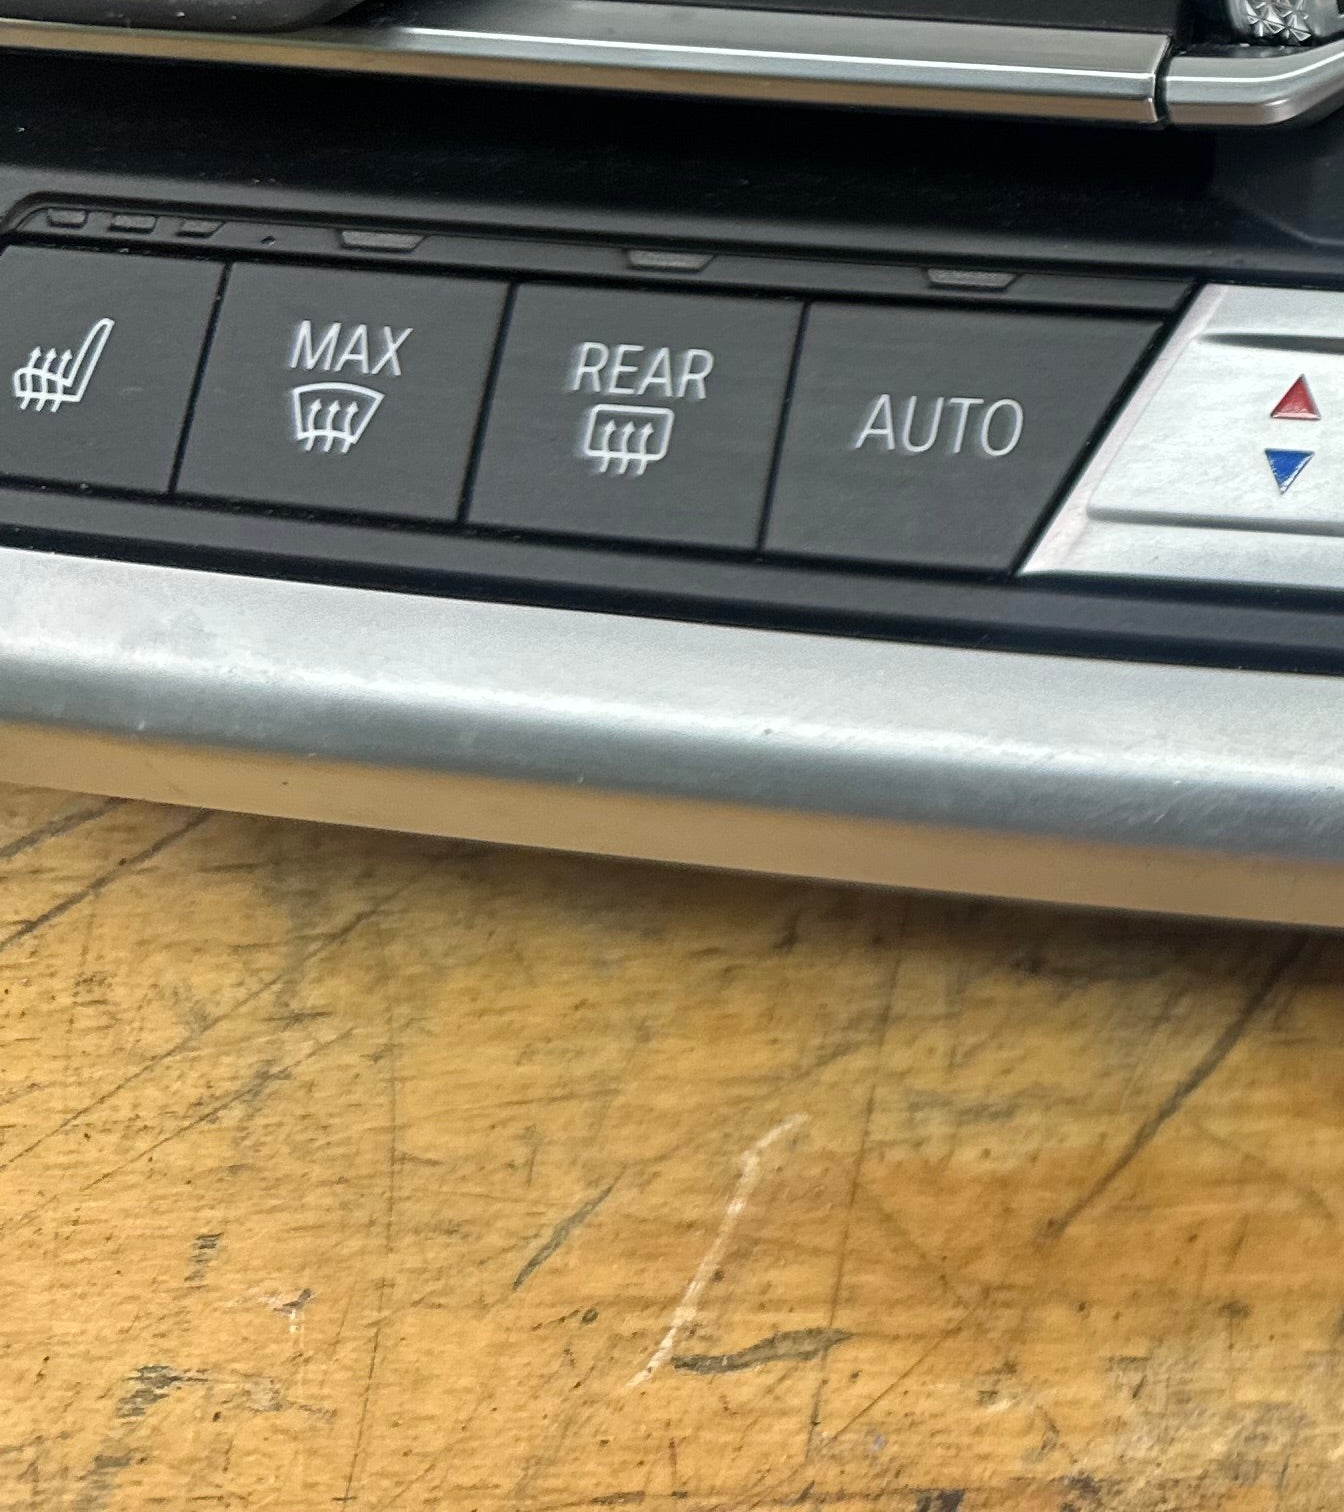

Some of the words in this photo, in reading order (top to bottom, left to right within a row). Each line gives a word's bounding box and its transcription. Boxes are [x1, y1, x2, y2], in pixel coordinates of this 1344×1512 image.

[289, 320, 413, 376] MAX
[572, 341, 713, 399] REAR
[855, 394, 1023, 457] AUTO
